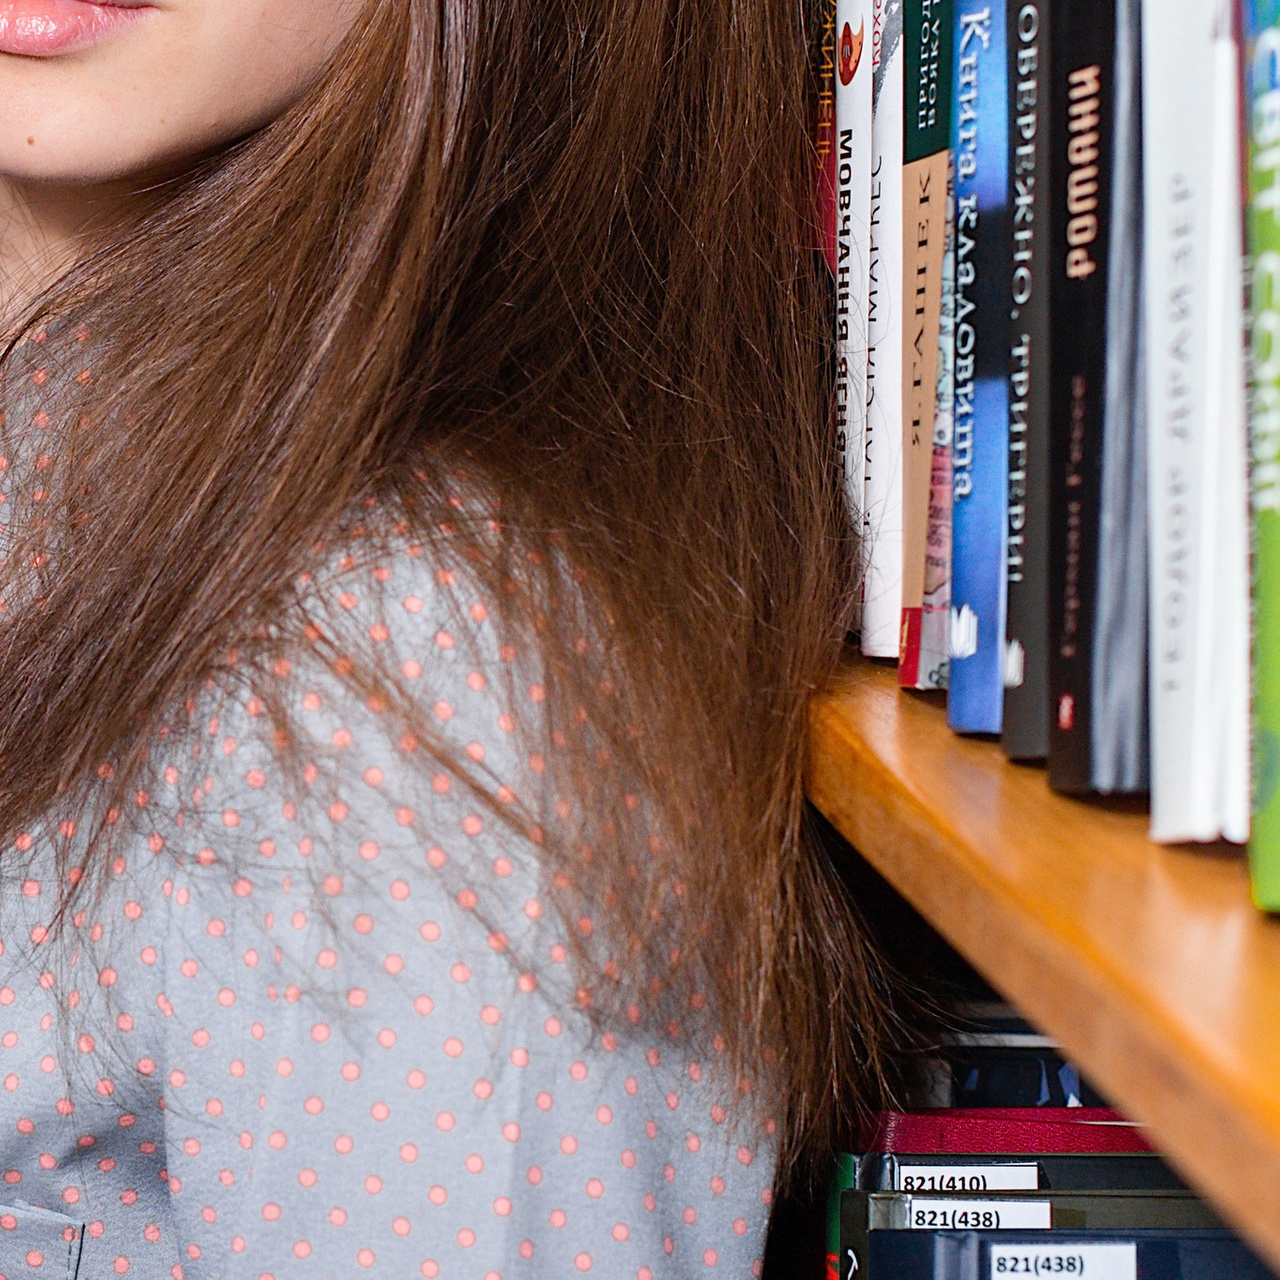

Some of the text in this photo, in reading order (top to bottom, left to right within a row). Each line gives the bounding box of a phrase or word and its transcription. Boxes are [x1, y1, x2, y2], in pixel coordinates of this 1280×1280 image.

[927, 18, 941, 128] ВОЯКА
[958, 6, 992, 184] Книга
[837, 129, 852, 341] МОВЧАННЯ
[904, 1175, 988, 1192] 821(410)
[915, 1209, 1001, 1228] 821(438)
[996, 1254, 1085, 1277] 821(438)
